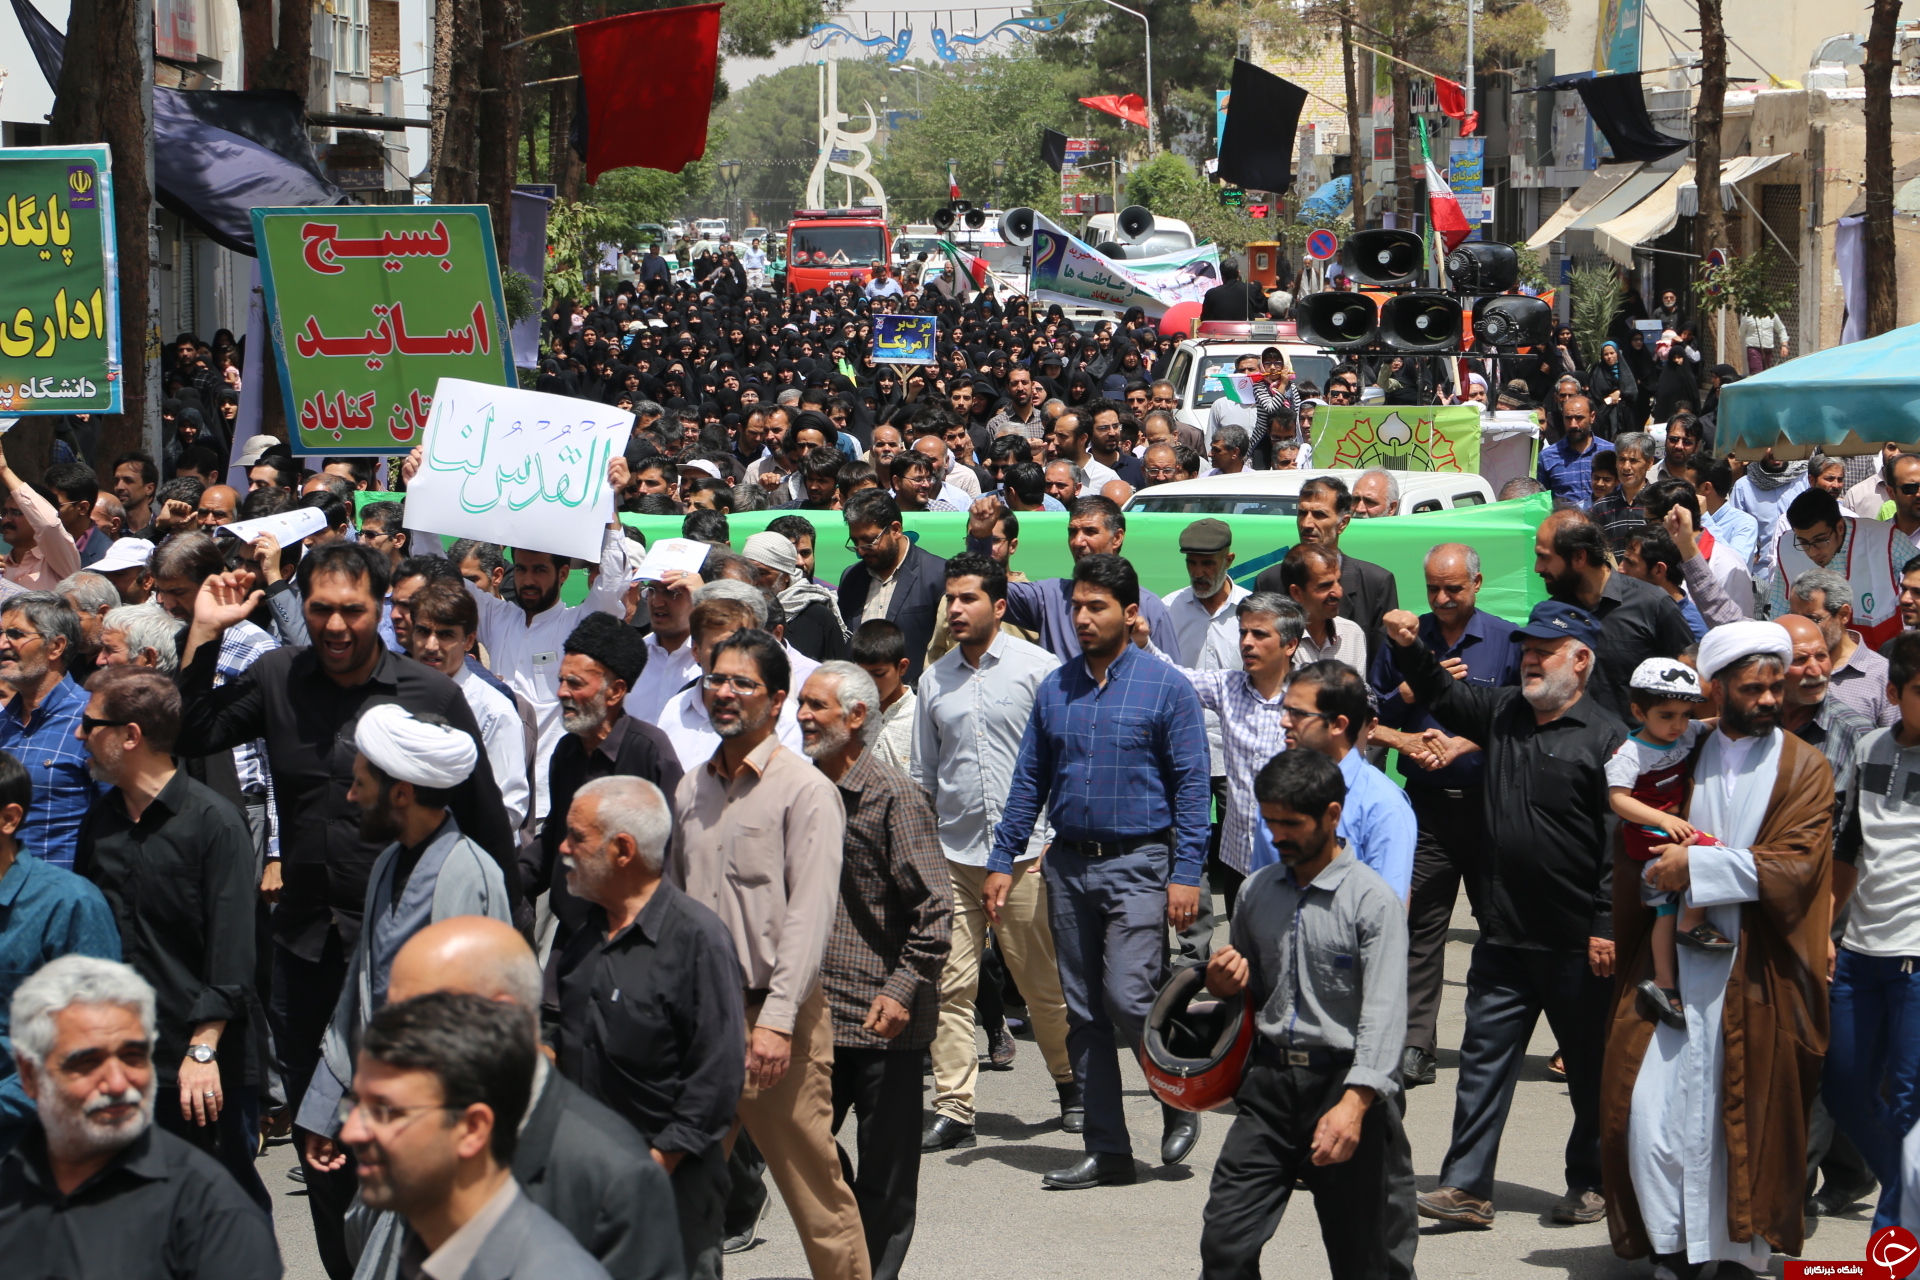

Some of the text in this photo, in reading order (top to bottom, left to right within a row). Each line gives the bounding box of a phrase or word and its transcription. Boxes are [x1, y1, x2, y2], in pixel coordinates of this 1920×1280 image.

[301, 220, 453, 274] بسیج
[0, 287, 104, 358] اداری
[296, 301, 490, 370] اساتید
[878, 333, 932, 354] آمریکا
[19, 376, 97, 398] دانشگاه
[301, 388, 433, 441] تان گناباد
